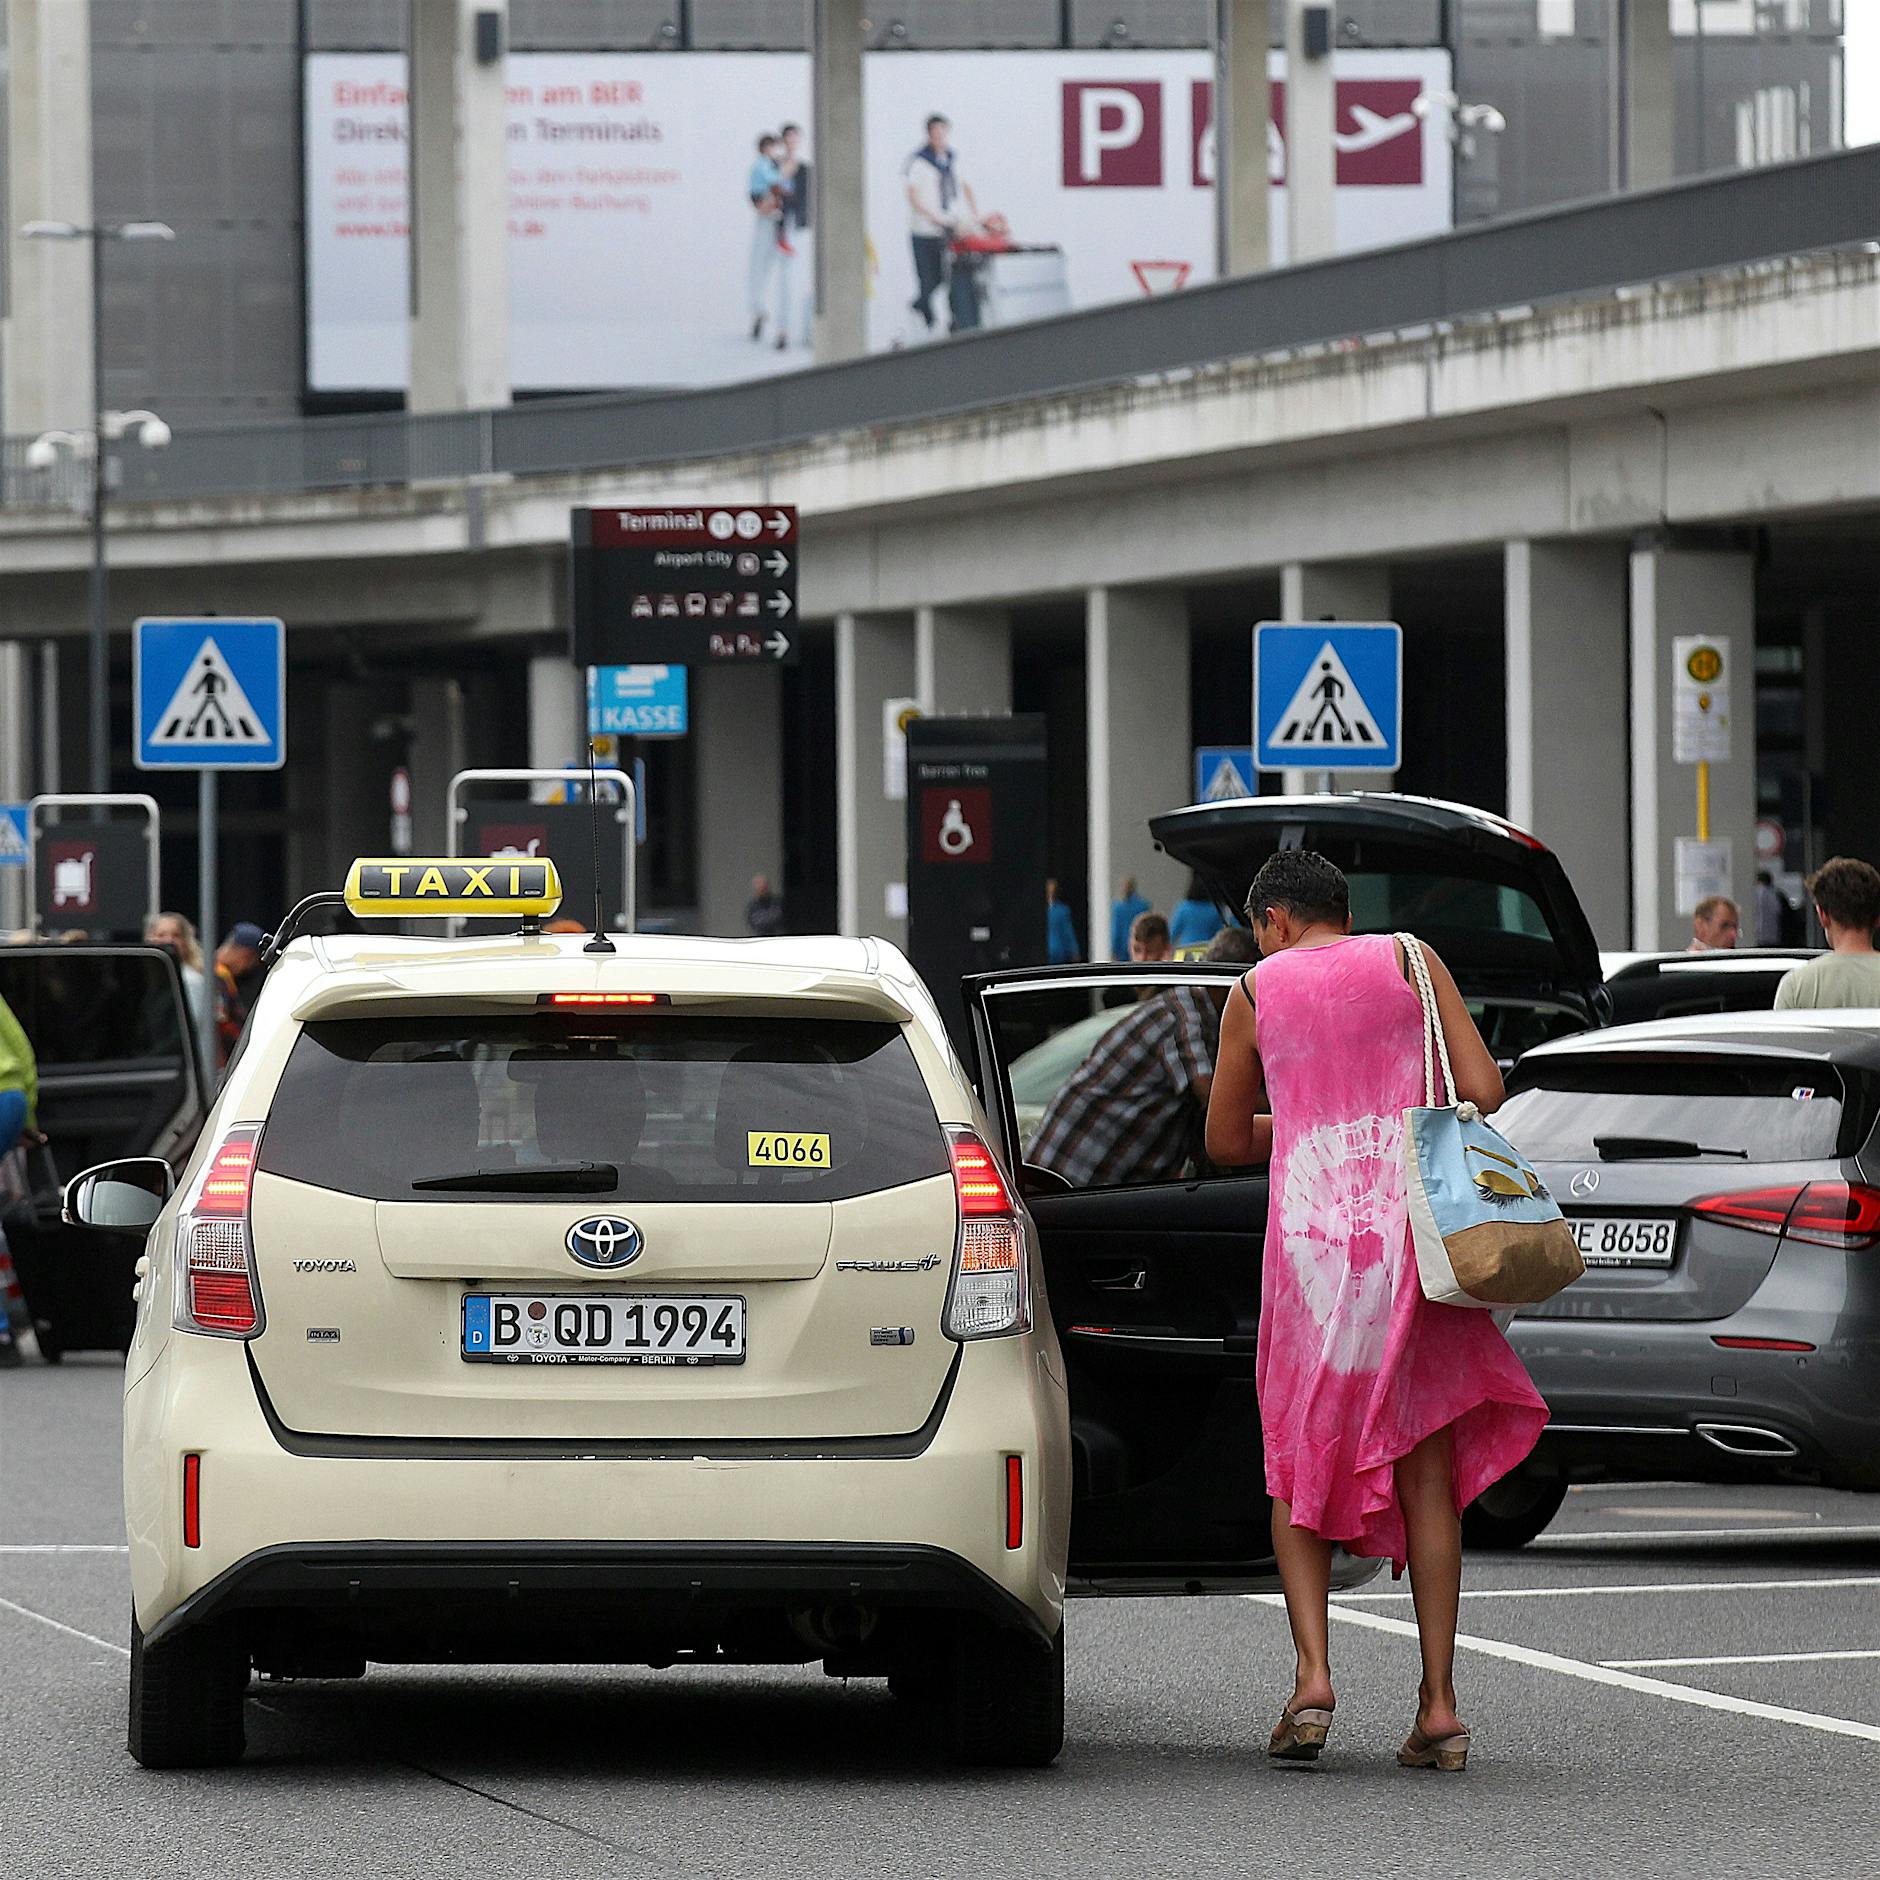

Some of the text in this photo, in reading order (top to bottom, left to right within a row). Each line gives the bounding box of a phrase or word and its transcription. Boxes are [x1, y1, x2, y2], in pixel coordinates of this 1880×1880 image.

[1080, 88, 1145, 183] P
[617, 510, 705, 531] Terminal
[602, 704, 681, 730] KASSE
[381, 866, 521, 896] TAXI
[755, 1136, 824, 1162] 4066
[1600, 1222, 1671, 1253] 8658
[292, 1259, 357, 1272] TOYOTA
[309, 1330, 338, 1339] INTAX
[471, 1330, 483, 1344] D
[494, 1303, 737, 1348] B QD 1994
[530, 1354, 676, 1365] TOYOTA Motor-Company BERLIN
